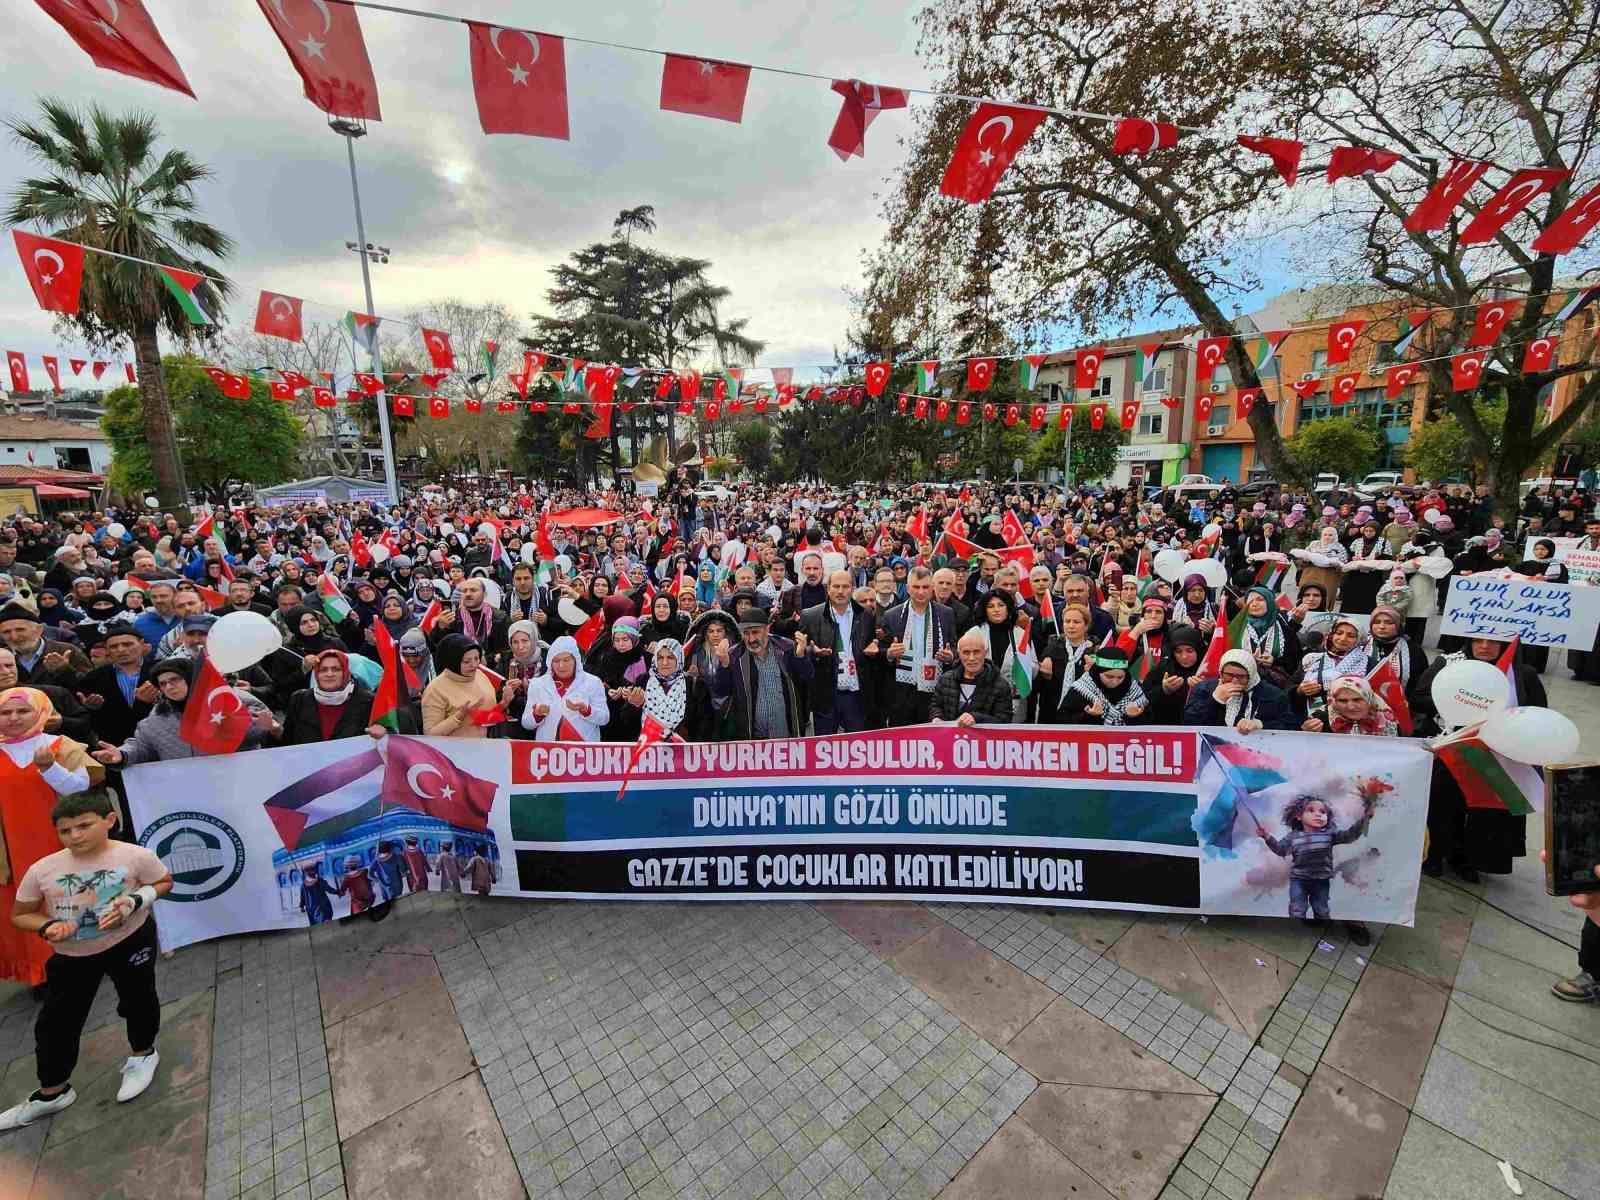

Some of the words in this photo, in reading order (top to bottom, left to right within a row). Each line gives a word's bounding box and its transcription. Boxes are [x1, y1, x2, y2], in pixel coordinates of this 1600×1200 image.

[1455, 579, 1510, 599] OLUK
[1520, 586, 1571, 607] OLUK
[1469, 597, 1514, 611] KAN
[530, 746, 674, 781] ÇOCUKLAR
[683, 740, 806, 773] UYURKEN
[815, 739, 944, 771] SUSULUR,
[1088, 738, 1182, 775] DEĞİL!
[693, 791, 826, 828] DÜNYA'NIN
[834, 788, 899, 826] GÖZÜ
[907, 788, 1007, 827] ÖNÜNDE
[628, 855, 748, 887] GAZZE'DE
[756, 853, 886, 889] ÇOCUKLAR
[894, 850, 1084, 892] KATLEDİLİYOR!
